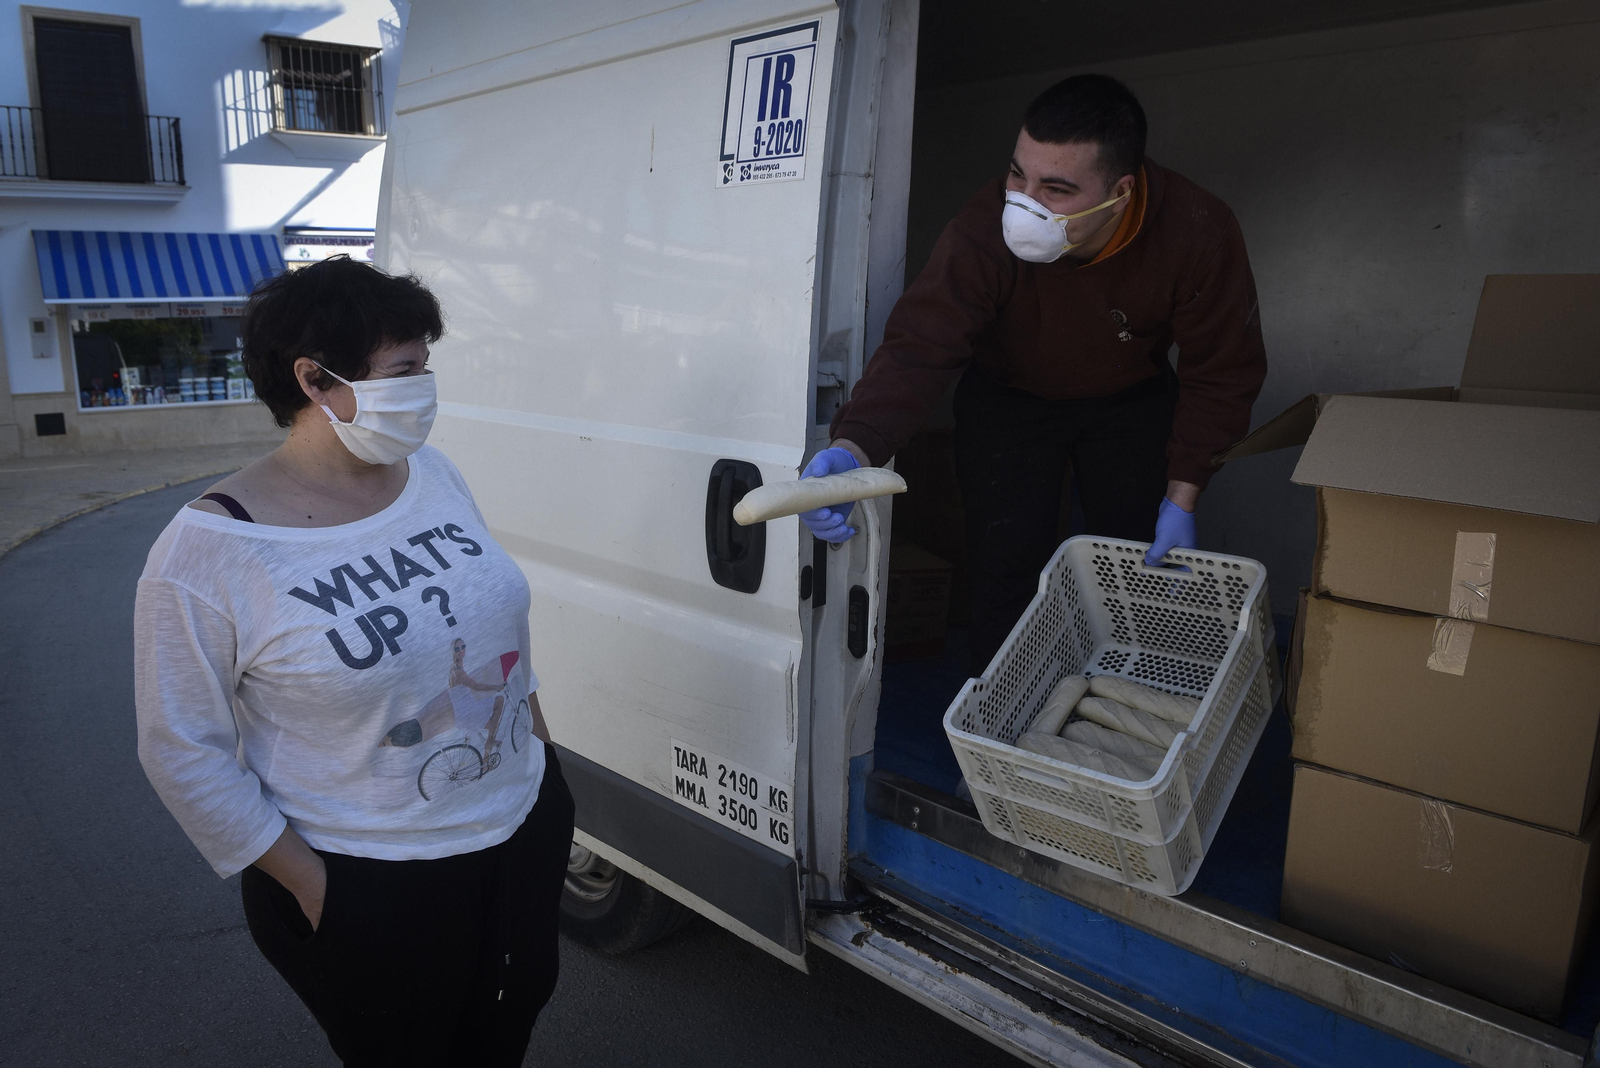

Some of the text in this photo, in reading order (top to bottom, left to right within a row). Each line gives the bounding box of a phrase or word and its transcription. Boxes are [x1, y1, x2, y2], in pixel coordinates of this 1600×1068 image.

[757, 54, 795, 122] IR
[753, 118, 803, 158] 9-2020
[287, 523, 483, 617] WHAT'S
[325, 586, 457, 670] UP ?
[674, 746, 788, 813] TARA 2190 KG
[718, 794, 758, 831] 3500
[769, 817, 789, 845] KG
